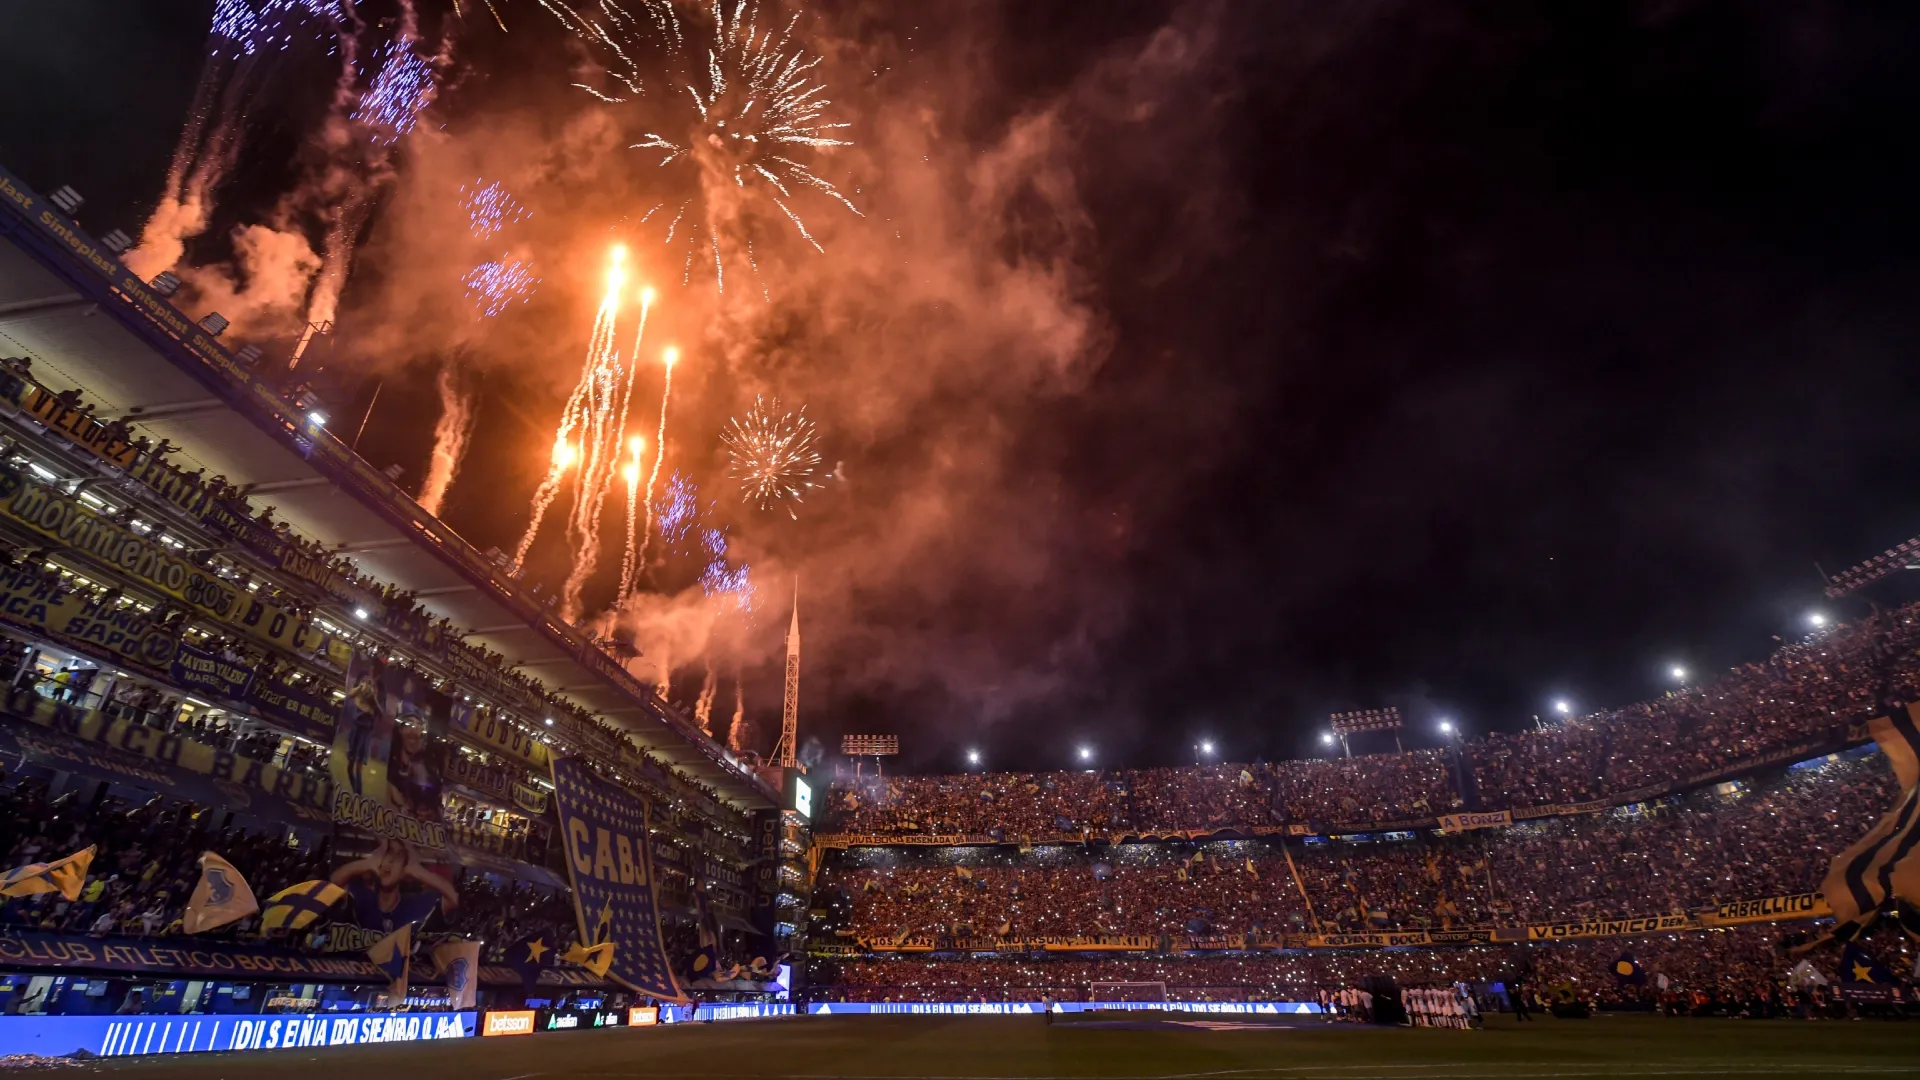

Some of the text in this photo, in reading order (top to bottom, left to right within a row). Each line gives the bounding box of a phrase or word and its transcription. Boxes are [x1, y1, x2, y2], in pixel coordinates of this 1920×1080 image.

[0, 177, 33, 209] last
[40, 211, 117, 276] Sinteplast
[122, 278, 188, 335] Sinteplast
[192, 334, 250, 384] Sinteplast
[211, 750, 332, 806] BARRI
[1459, 812, 1506, 827] BONZI
[569, 816, 646, 886] CABJ
[905, 836, 950, 845] ENSENADA
[758, 819, 778, 907] betsn
[1718, 893, 1814, 918] CABALLITO
[1389, 932, 1425, 945] BOCA
[0, 938, 96, 963] CLUB
[238, 953, 310, 974] BOCA
[309, 957, 377, 976] JUNIOR
[489, 1015, 530, 1033] betsson
